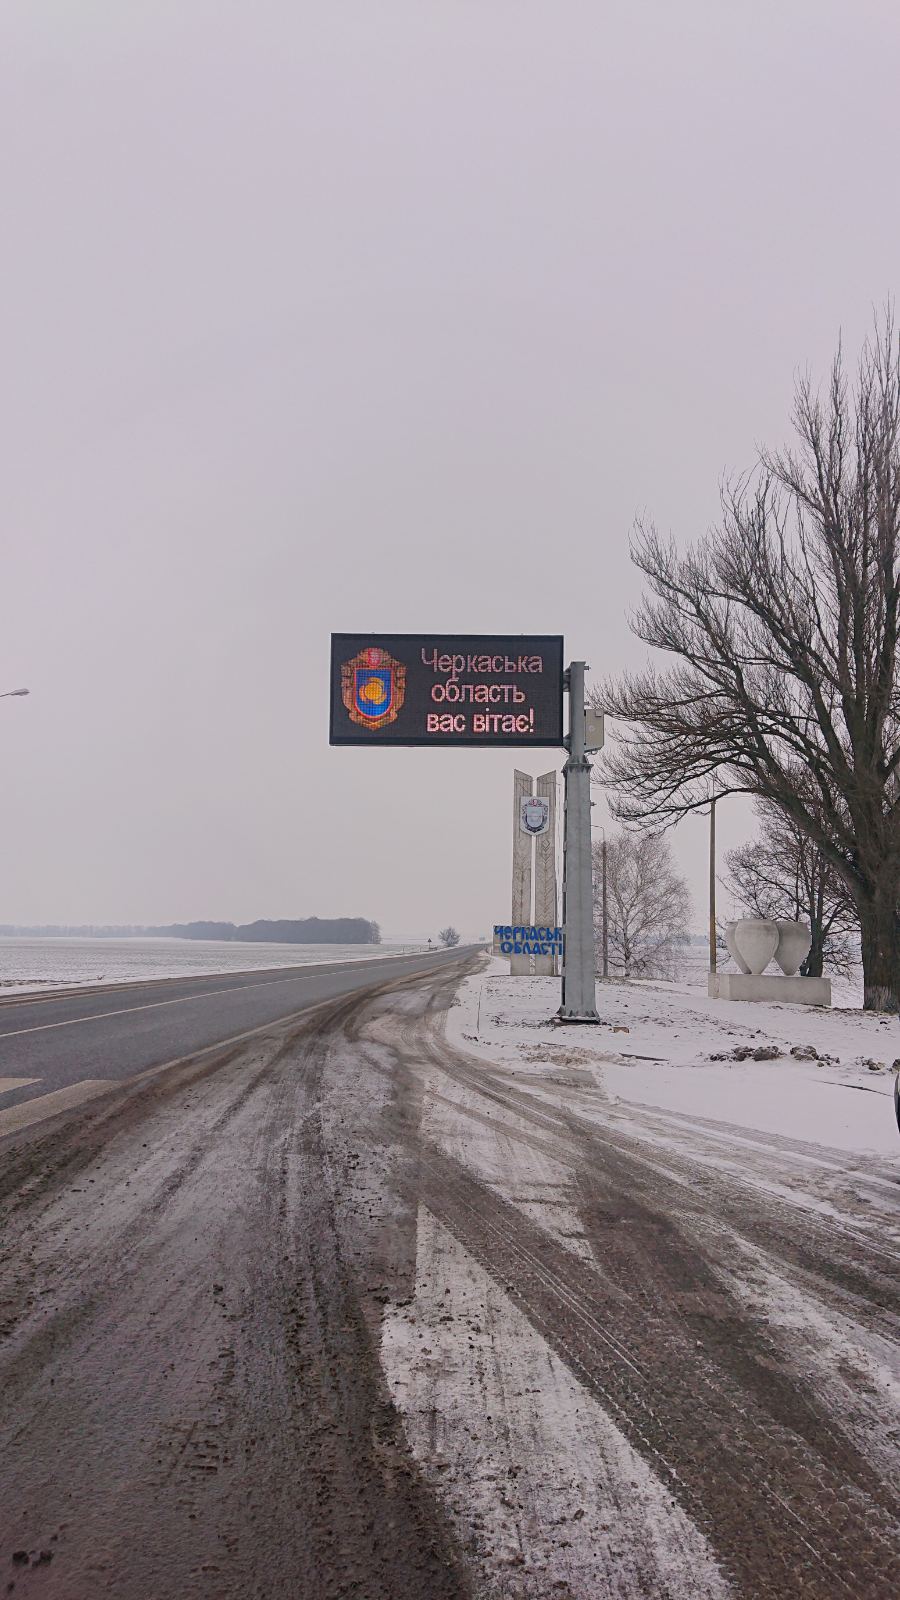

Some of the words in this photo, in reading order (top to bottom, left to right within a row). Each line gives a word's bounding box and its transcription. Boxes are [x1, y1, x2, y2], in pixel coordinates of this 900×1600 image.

[421, 648, 543, 679] Черкаська
[431, 678, 526, 702] область
[427, 713, 466, 732] вас
[473, 707, 534, 732] вітає!
